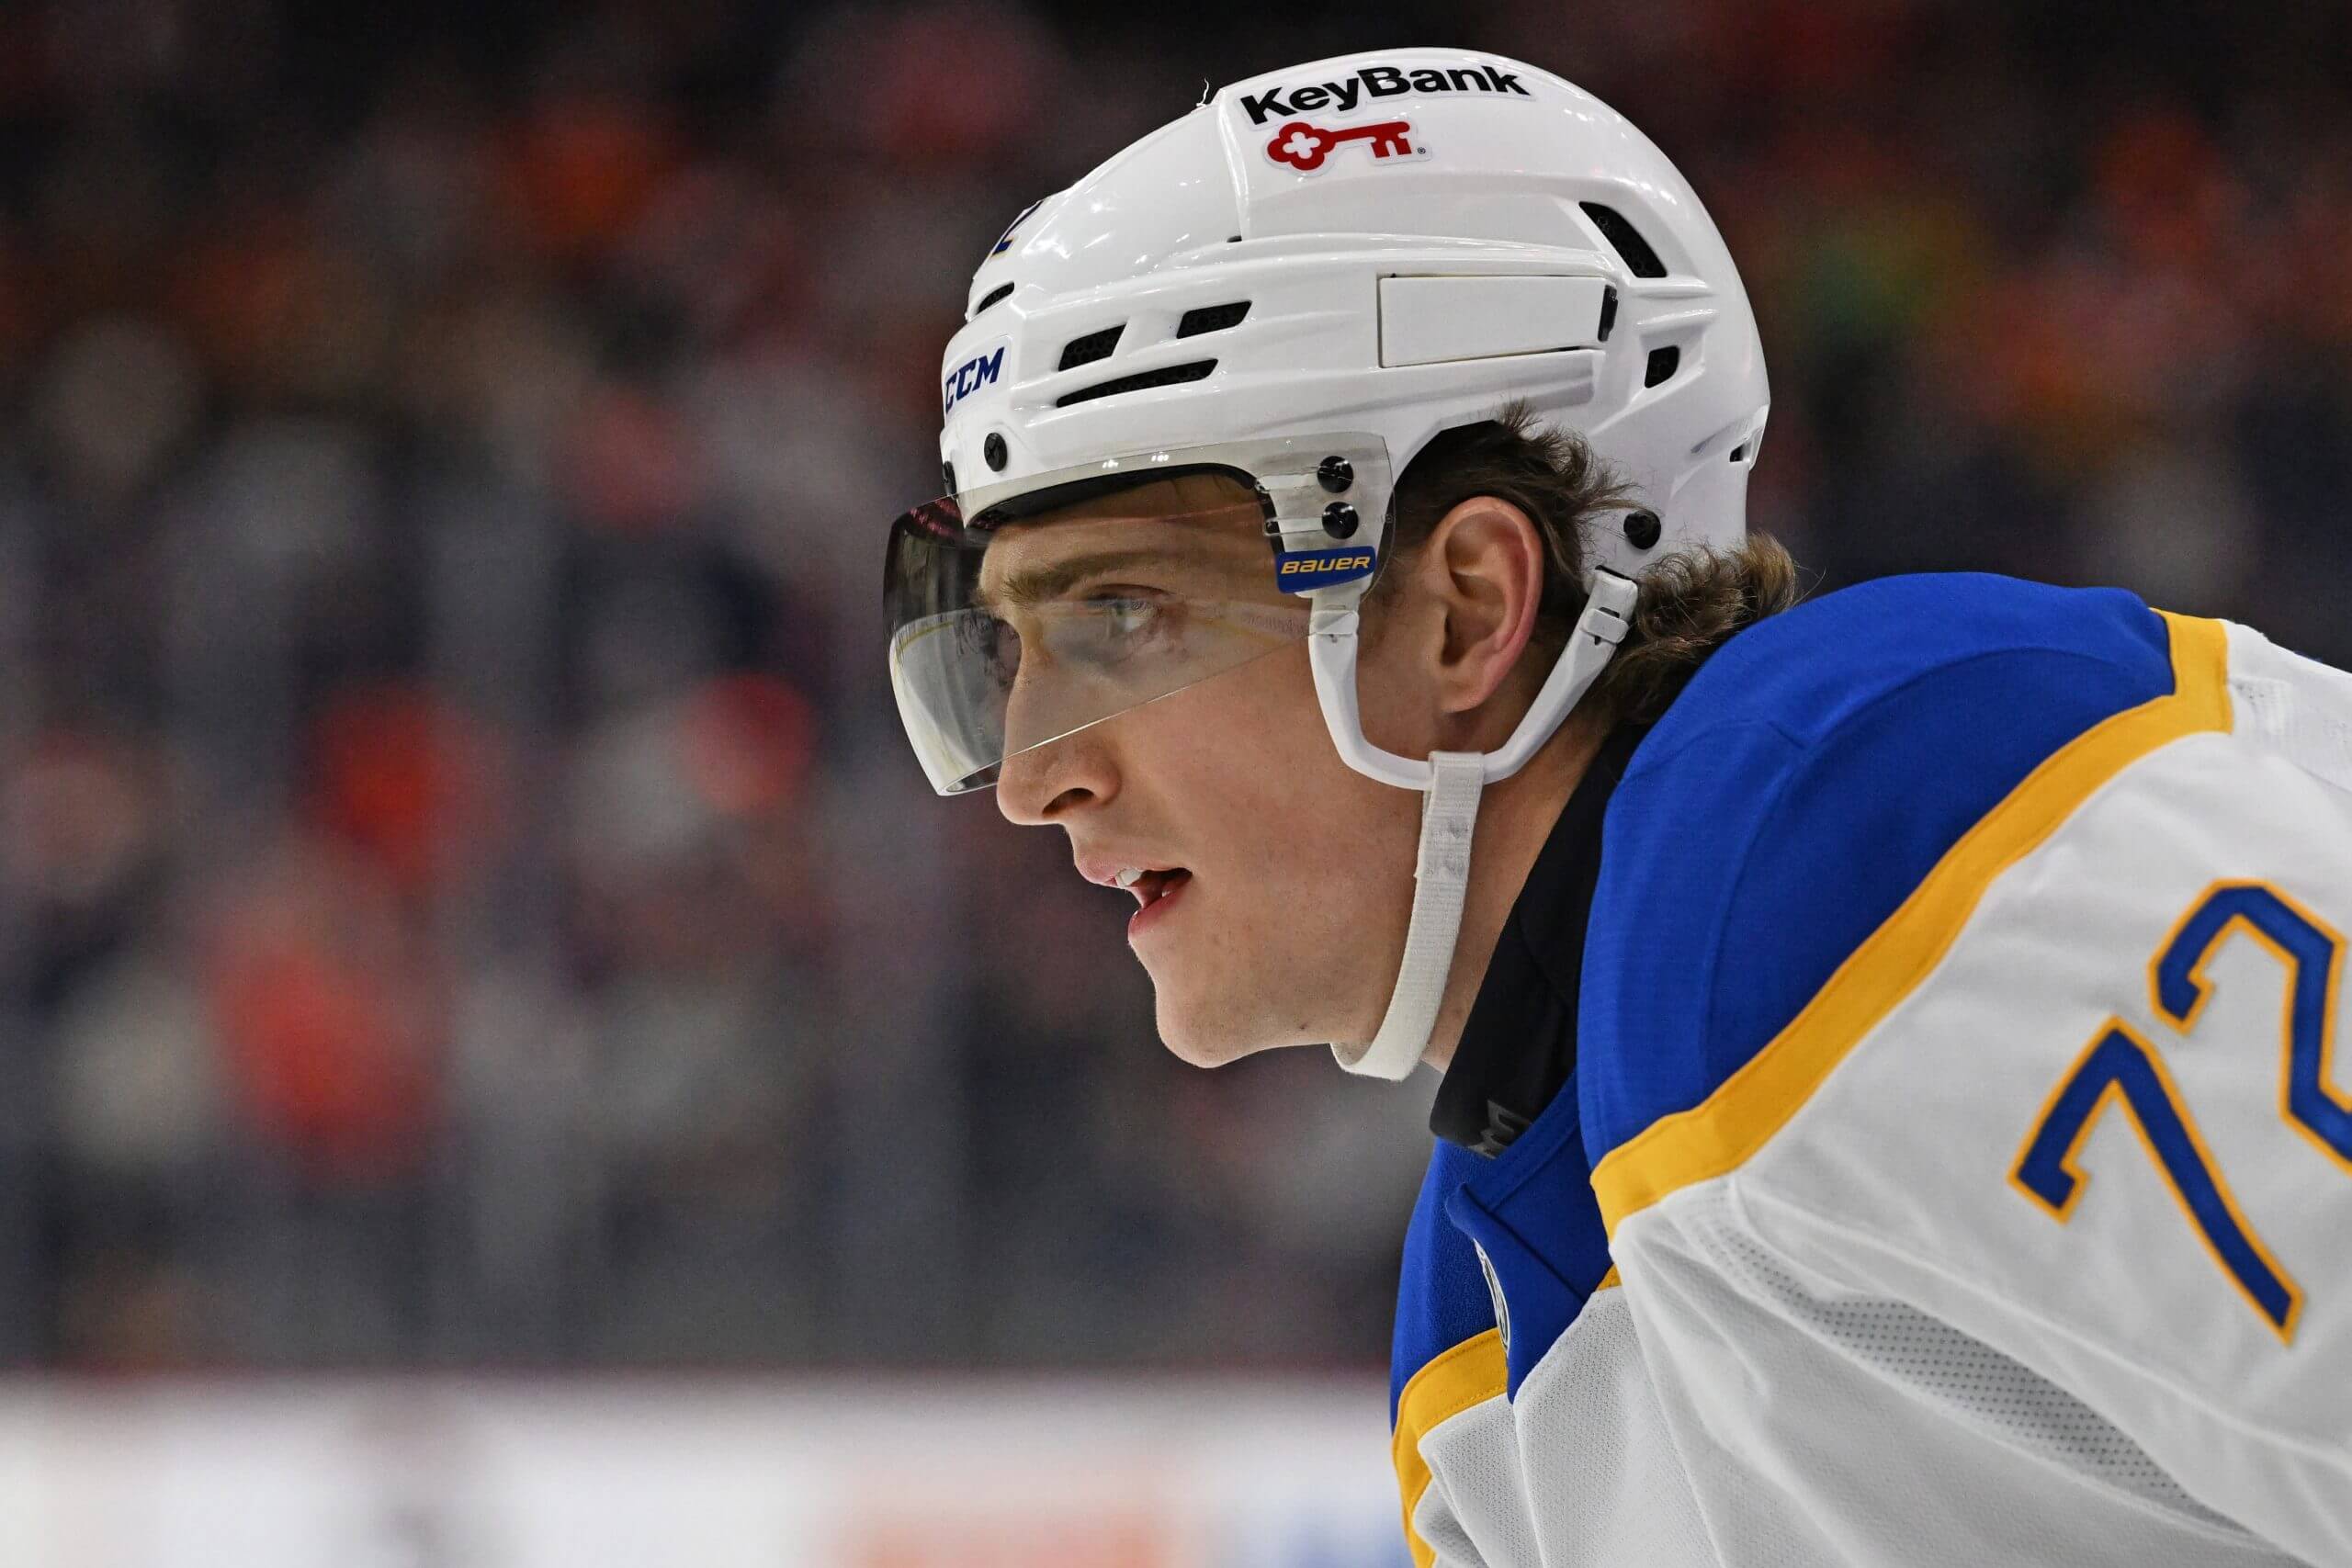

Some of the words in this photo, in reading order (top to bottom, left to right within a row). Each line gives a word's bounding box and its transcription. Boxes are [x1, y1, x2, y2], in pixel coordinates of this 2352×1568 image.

[1240, 66, 1531, 125] KeyBank
[945, 346, 1004, 413] CCM
[1281, 556, 1371, 574] BAUER
[2007, 878, 2352, 1346] 72
